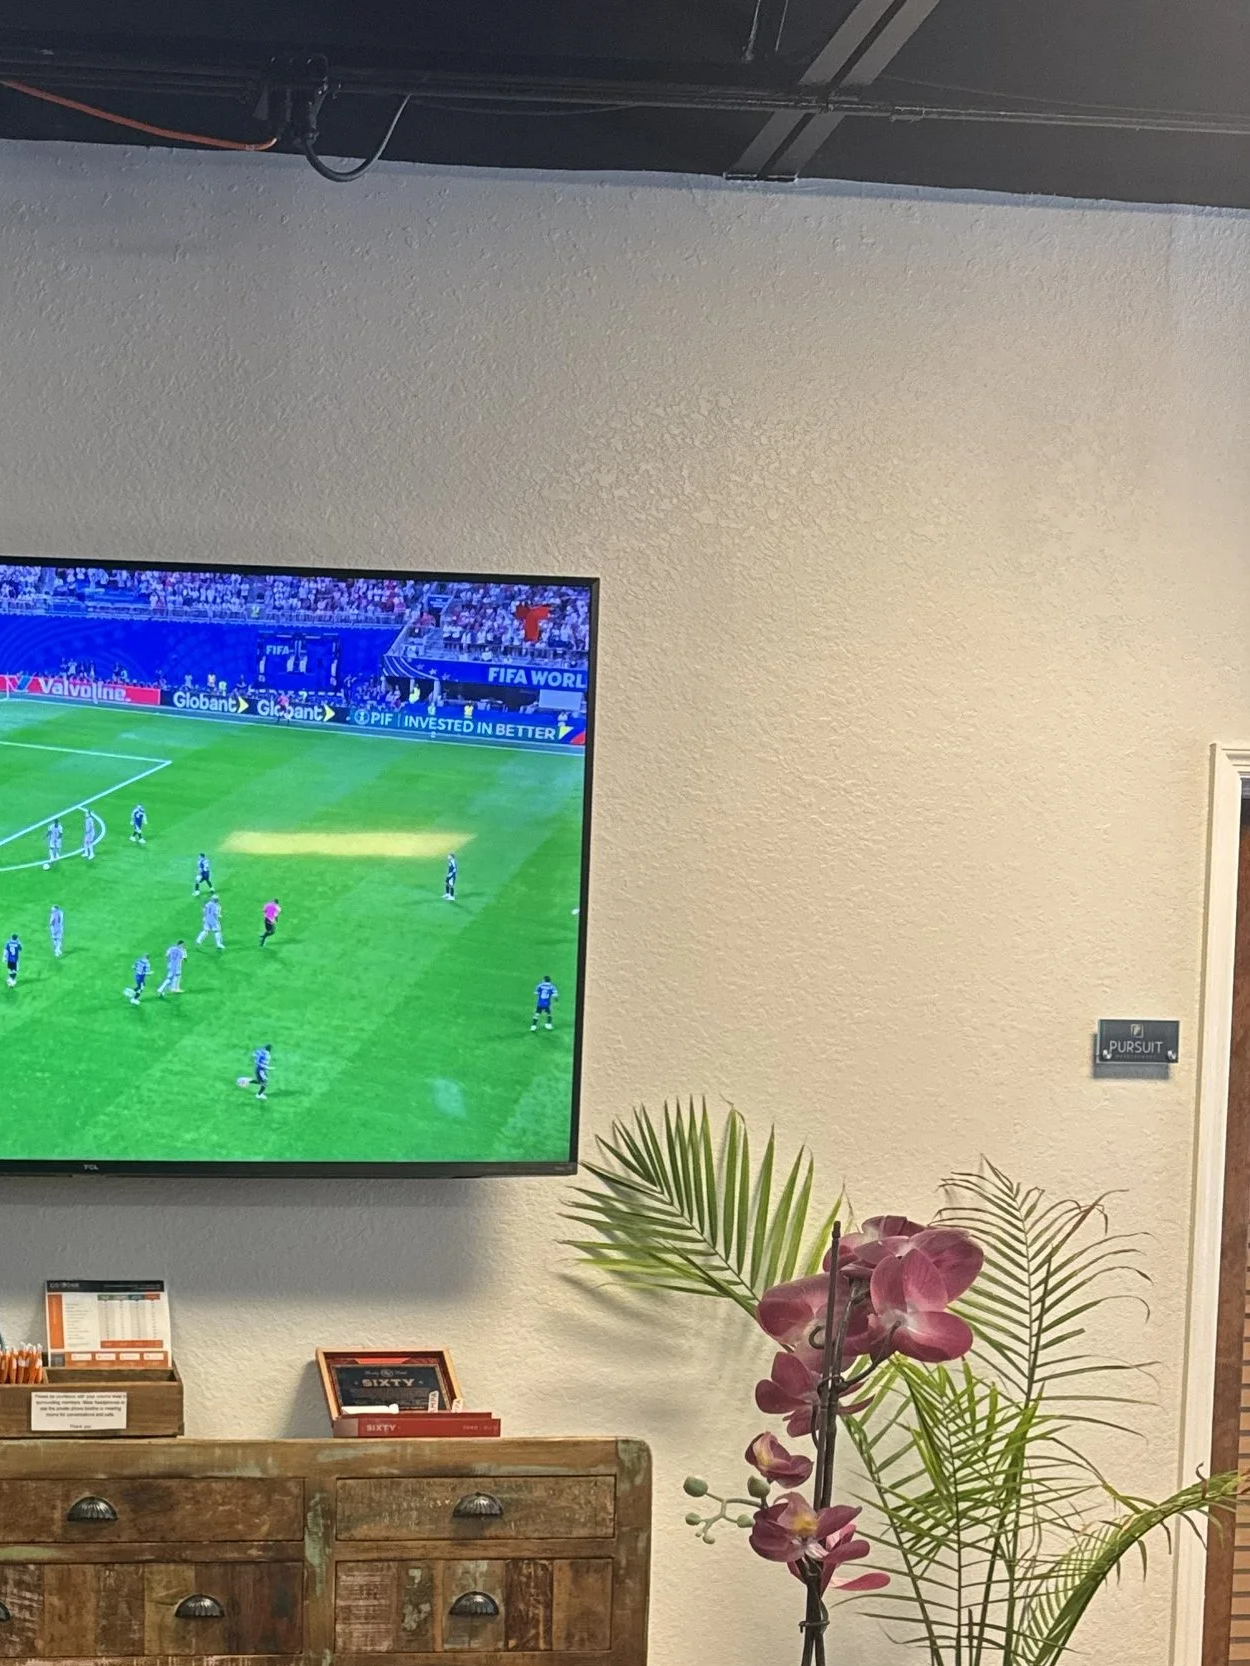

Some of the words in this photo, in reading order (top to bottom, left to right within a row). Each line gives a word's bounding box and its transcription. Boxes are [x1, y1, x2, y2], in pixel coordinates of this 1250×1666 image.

[266, 645, 289, 655] FIFA
[488, 667, 529, 685] FIFA
[531, 670, 587, 689] WORL
[37, 675, 127, 704] Valvoline
[173, 691, 237, 713] Globant
[370, 711, 393, 726] PIF
[404, 714, 474, 734] INVESTED
[477, 721, 493, 736] IN
[495, 723, 557, 741] BETTER
[1109, 1040, 1164, 1054] PURSUIT
[82, 1163, 99, 1171] TCL
[361, 1378, 415, 1388] SIXTY
[366, 1424, 397, 1432] SIXTY
